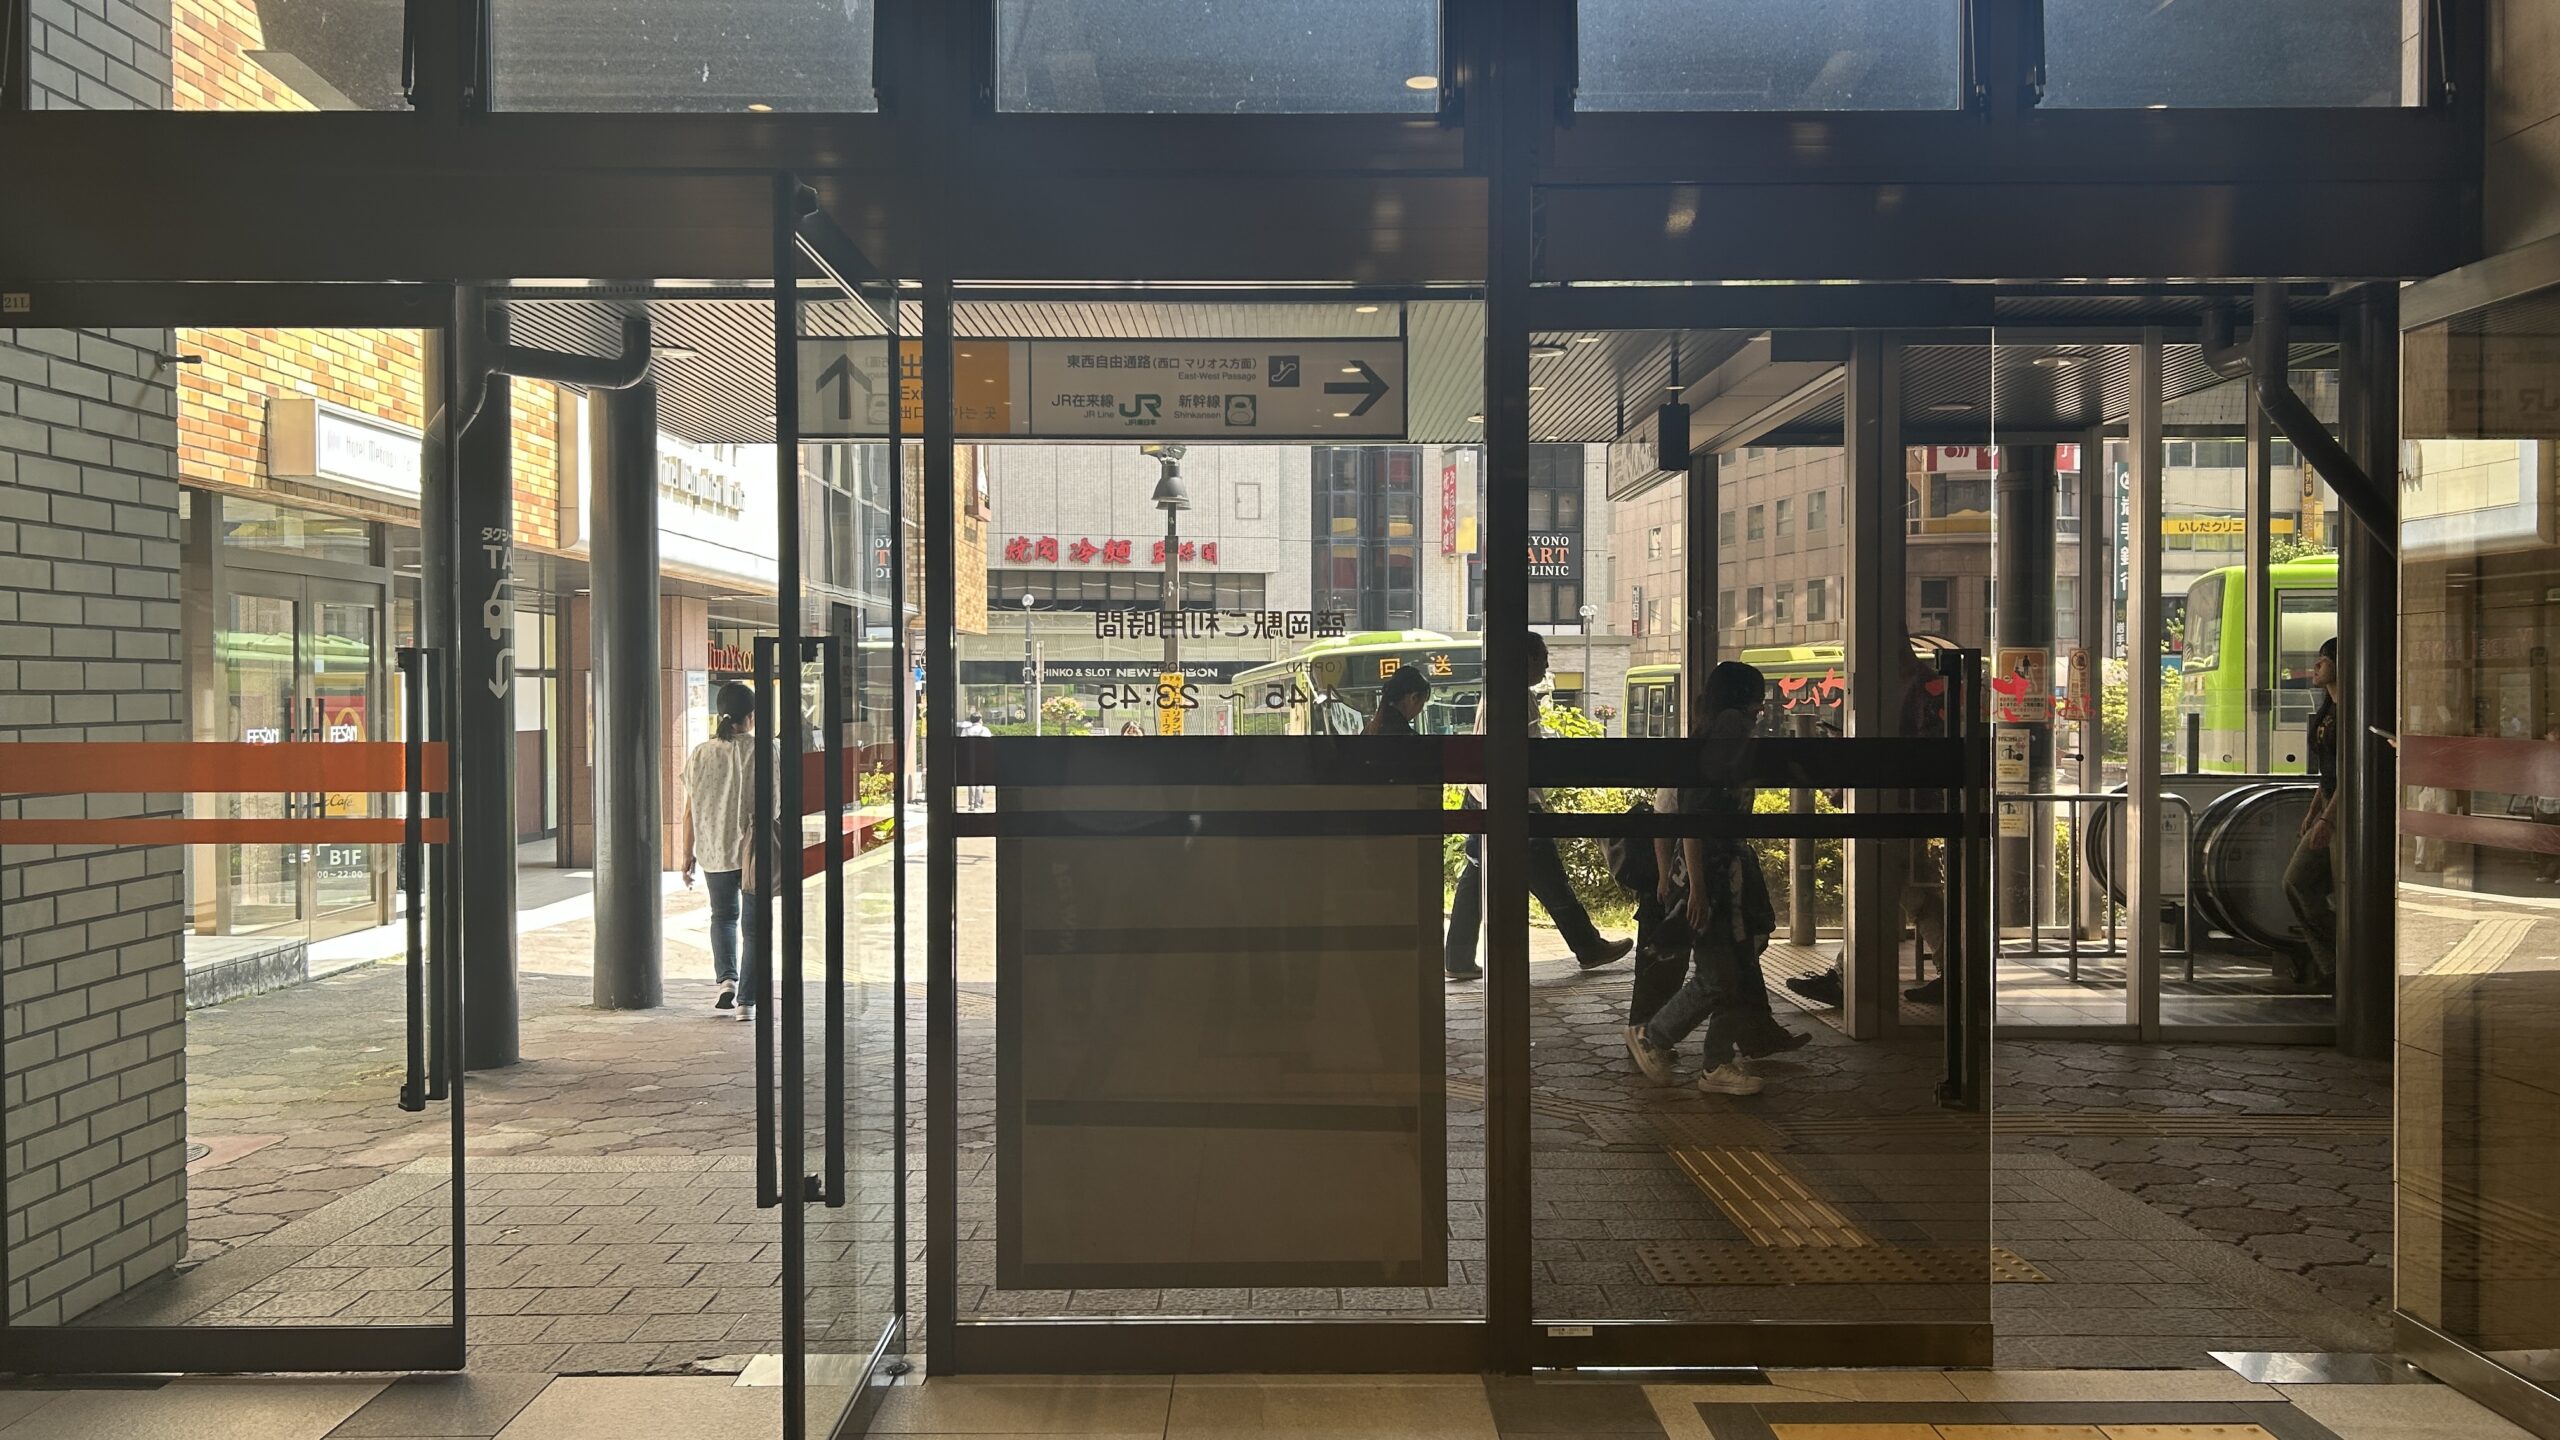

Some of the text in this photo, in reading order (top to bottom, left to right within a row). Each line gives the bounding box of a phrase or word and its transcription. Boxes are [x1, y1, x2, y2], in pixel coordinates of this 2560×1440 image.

[901, 353, 923, 380] 出
[1178, 371, 1257, 382] East-West Passage
[901, 386, 923, 400] Exi
[1051, 394, 1114, 408] JR在来線
[1118, 394, 1163, 418] JR
[1178, 394, 1221, 408] 新幹線
[952, 406, 978, 419] 가는
[1083, 411, 1115, 419] JR Line
[1174, 411, 1221, 420] Shinkansen
[481, 527, 513, 541] タクシ
[2178, 521, 2244, 533] いしだクリニ
[1528, 536, 1570, 546] YONO
[1005, 536, 1059, 563] 焼肉
[1528, 547, 1570, 564] ART
[482, 544, 513, 571] TA
[1528, 565, 1570, 576] LINIC
[1022, 668, 1073, 678] AHINKO
[1085, 668, 1111, 677] SLOT
[1116, 668, 1151, 678] NEW
[329, 849, 362, 866] B1F
[317, 870, 363, 879] 00~22:00
